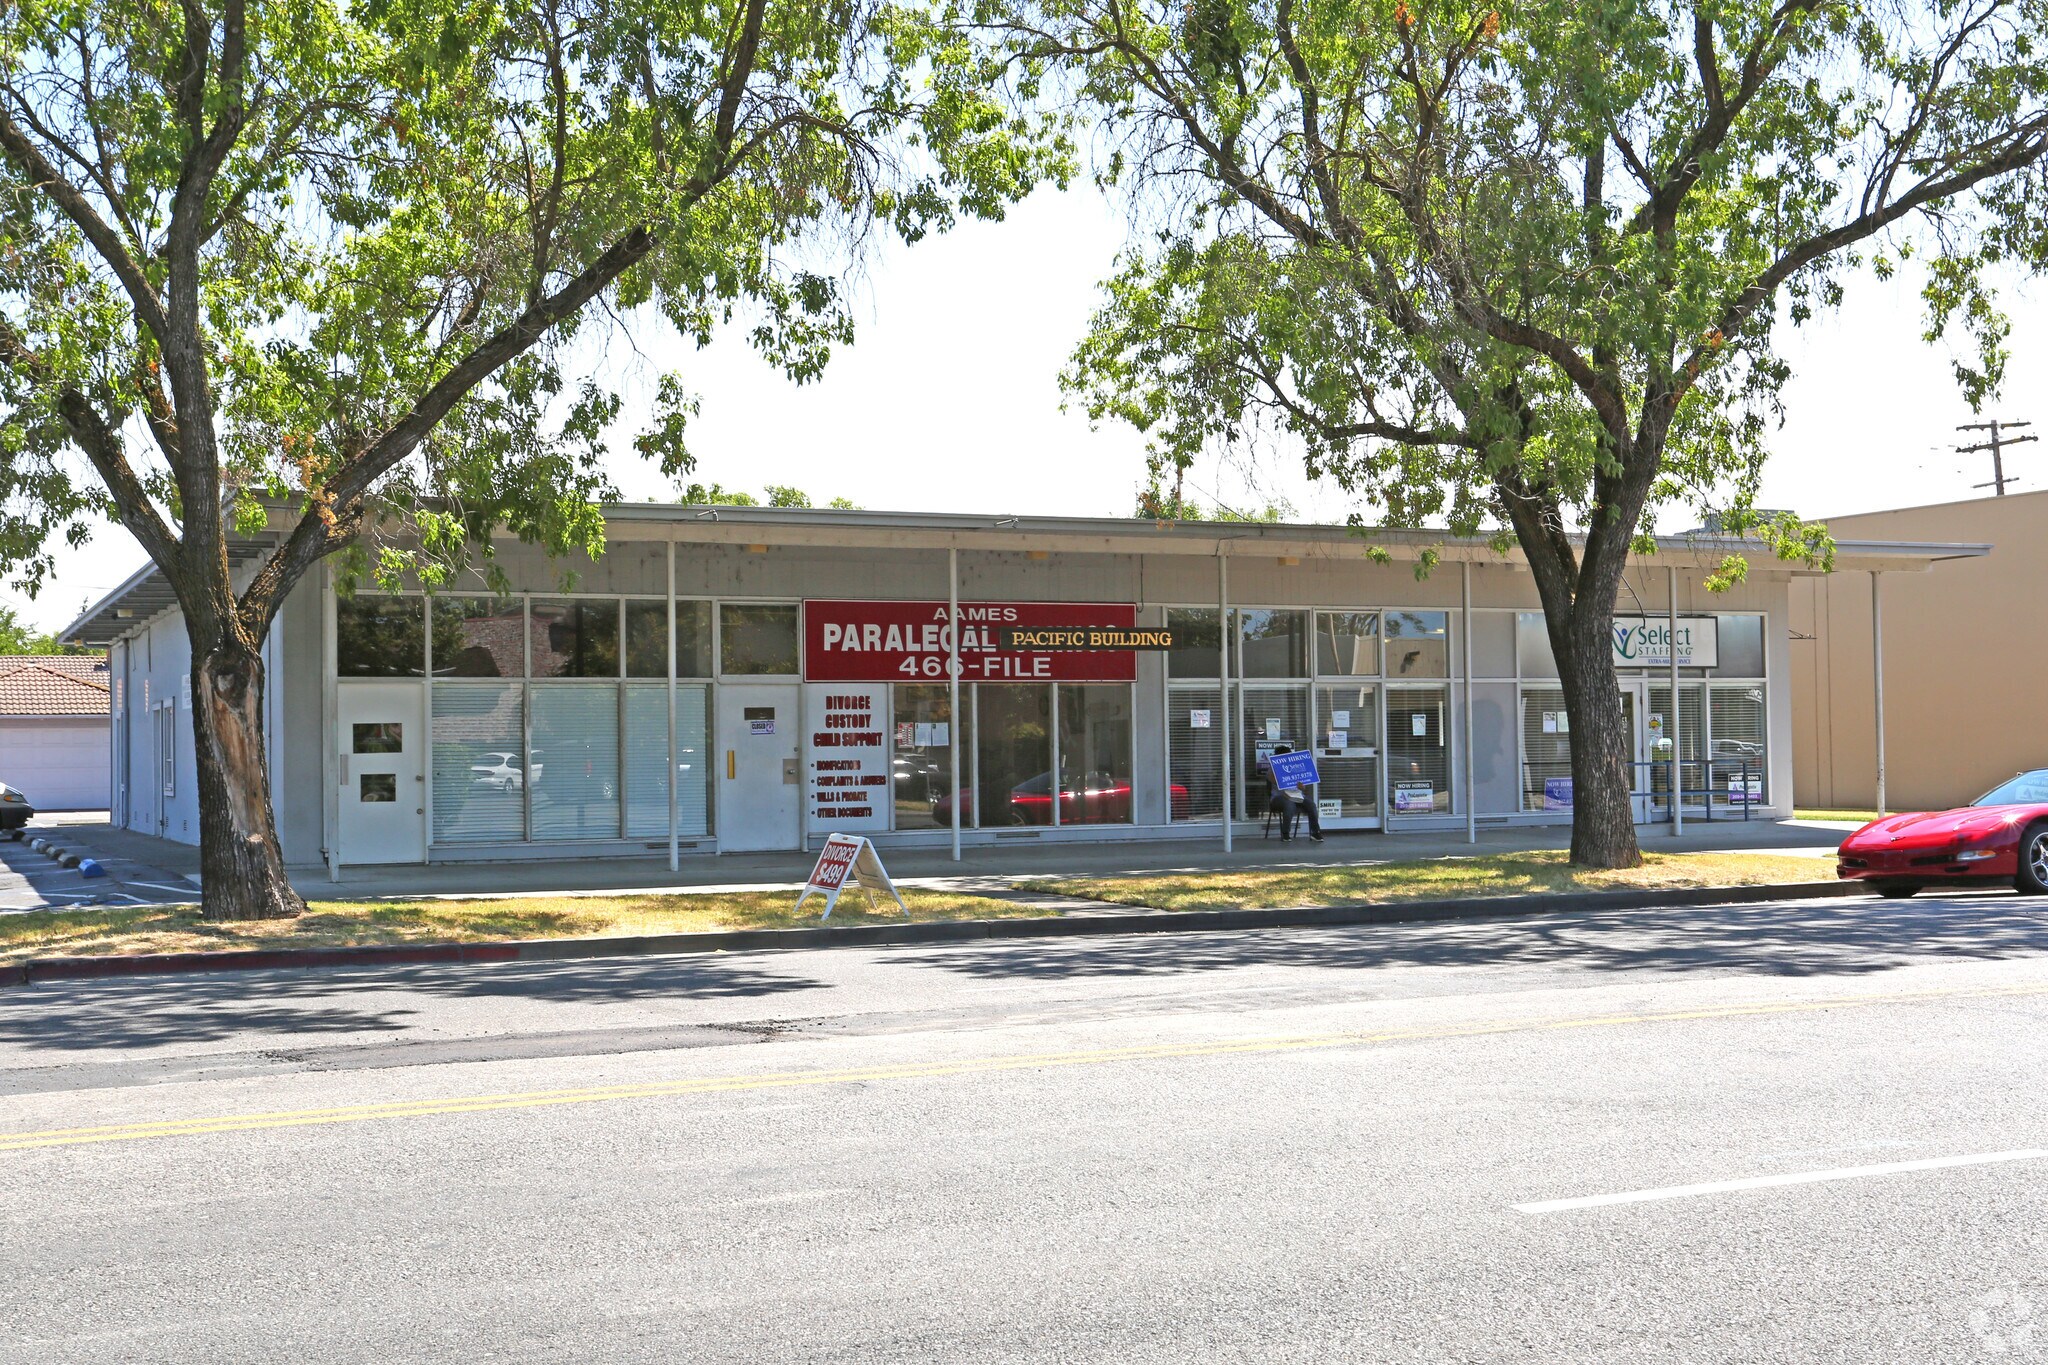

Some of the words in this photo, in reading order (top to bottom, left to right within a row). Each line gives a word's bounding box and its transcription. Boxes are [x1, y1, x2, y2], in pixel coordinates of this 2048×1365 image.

[933, 607, 1018, 621] AAMES
[1012, 632, 1084, 646] PACIFIC
[1089, 632, 1172, 646] BUILDING
[1638, 625, 1691, 645] Select
[1638, 647, 1691, 655] STAFFNG
[899, 656, 1052, 677] 466-FILE
[826, 695, 871, 710] DIVORCE
[825, 714, 871, 728] CUSTODY
[813, 732, 841, 747] CHILD
[842, 732, 883, 747] SUPPORT
[1288, 753, 1311, 763] HIRING
[854, 776, 859, 786] &
[817, 792, 834, 802] WILLS
[836, 792, 840, 802] &
[817, 807, 837, 818] OTHER
[837, 807, 872, 818] DOCUMENTS
[823, 844, 856, 863] DIVORCE
[816, 862, 844, 885] $499
